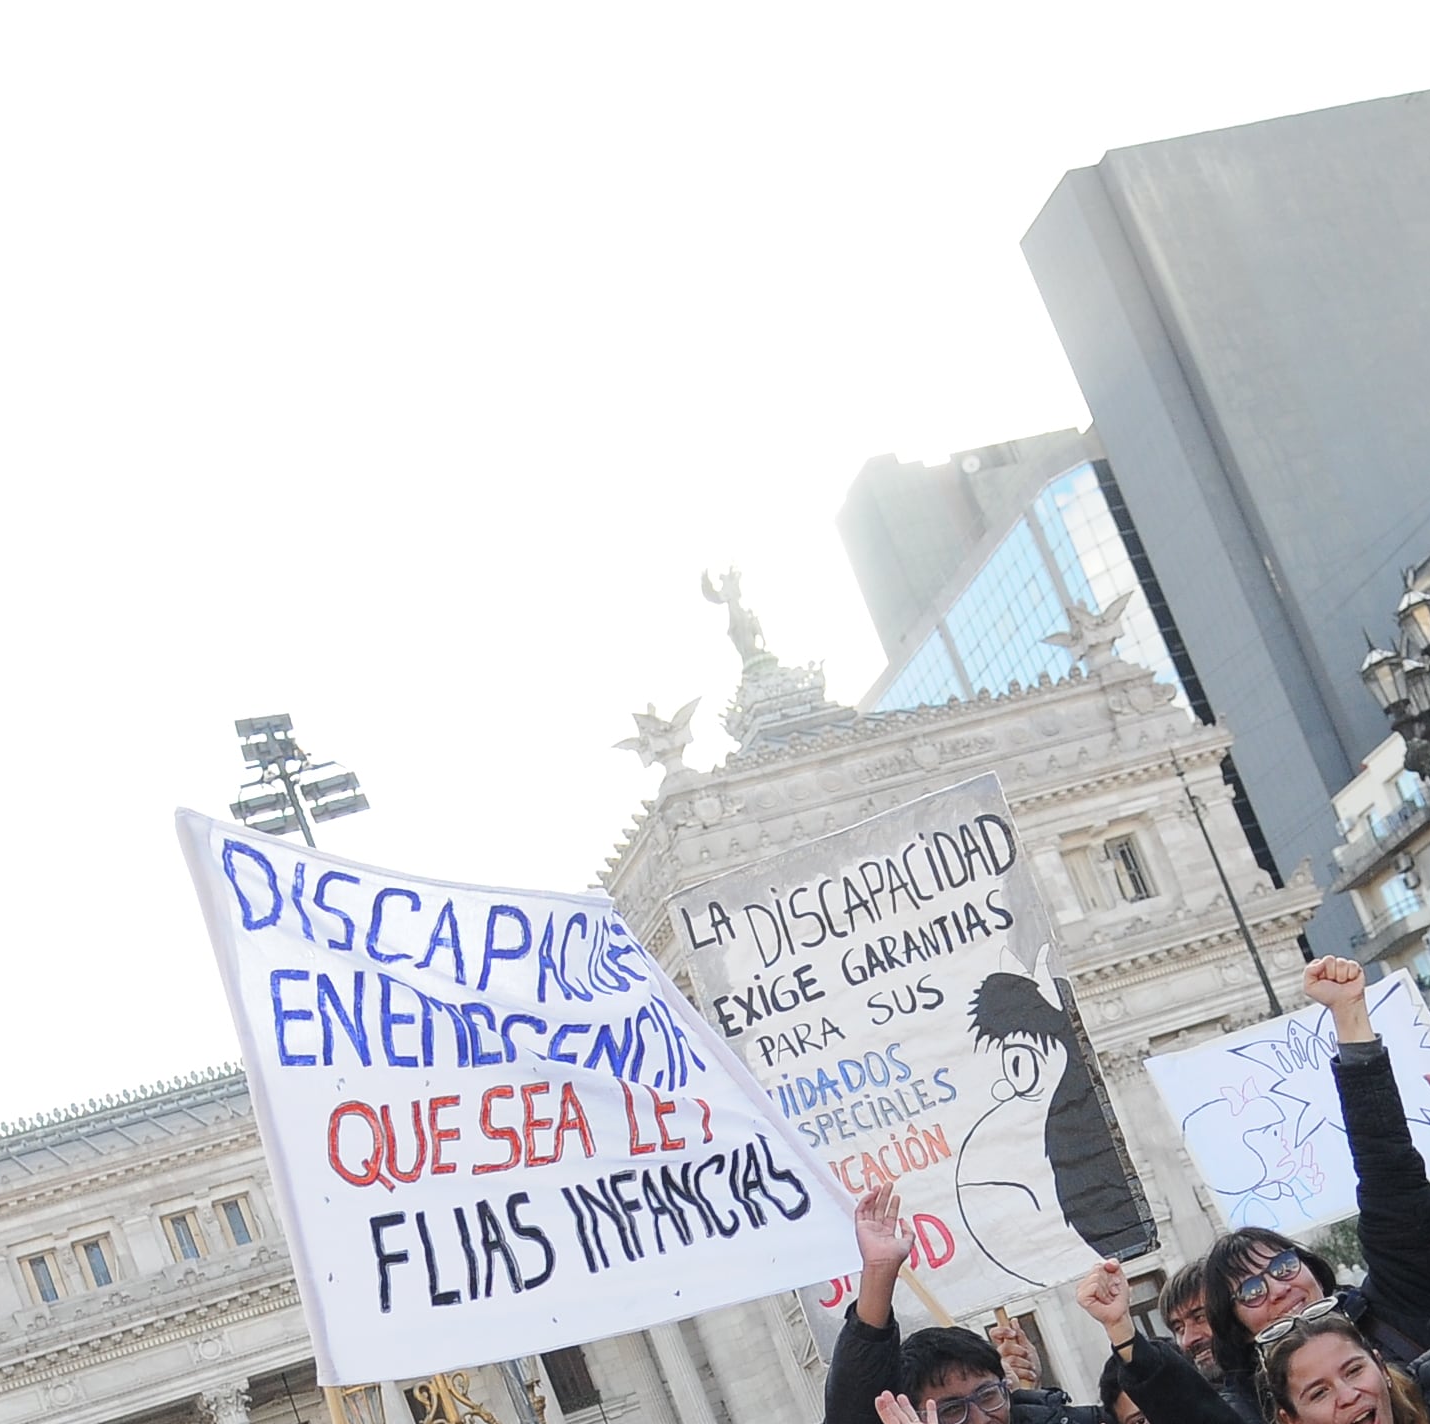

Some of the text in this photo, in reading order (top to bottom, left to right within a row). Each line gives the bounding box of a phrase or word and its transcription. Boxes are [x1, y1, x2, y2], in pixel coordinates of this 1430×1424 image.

[680, 813, 1017, 968] LA DISCAPACIDAD
[713, 889, 1014, 1038] EXIGE GARANTIAS
[754, 973, 945, 1067] PARA SUS
[797, 1066, 958, 1149] SPECIALES
[370, 1188, 555, 1314] FLIAS
[560, 1133, 811, 1274] INFANCIAS
